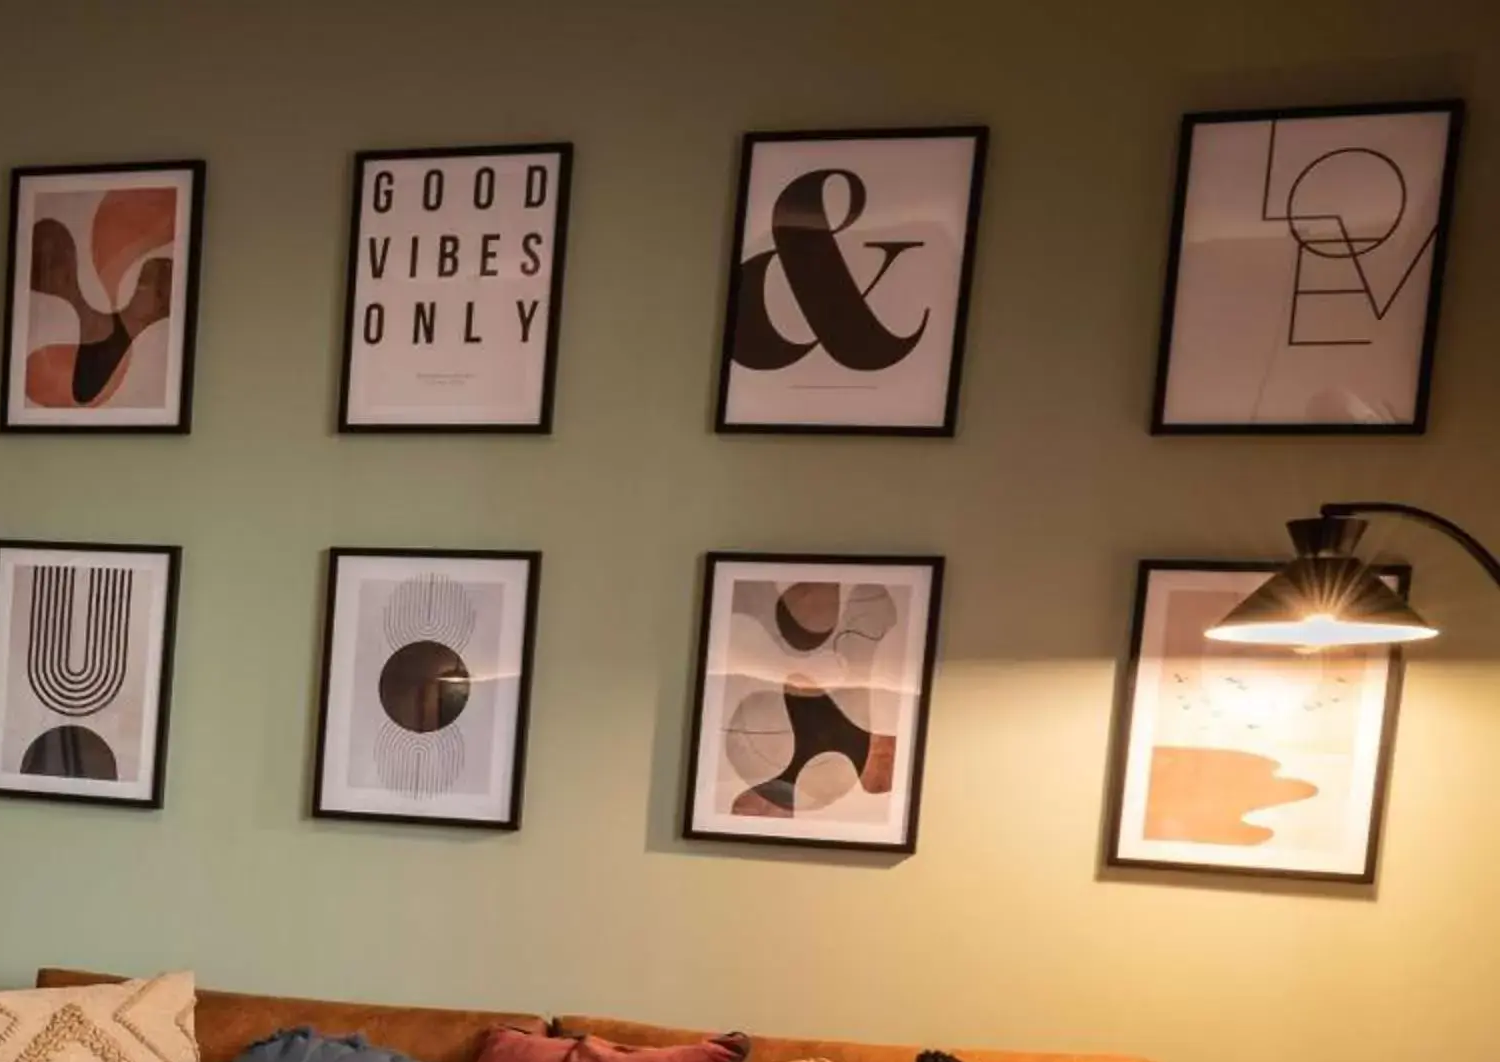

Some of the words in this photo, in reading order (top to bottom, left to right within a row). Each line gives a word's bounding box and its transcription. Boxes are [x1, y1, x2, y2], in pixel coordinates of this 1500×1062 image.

[372, 164, 548, 214] GOOD
[368, 232, 543, 279] VIBES
[729, 168, 930, 371] &
[363, 300, 539, 345] ONLY
